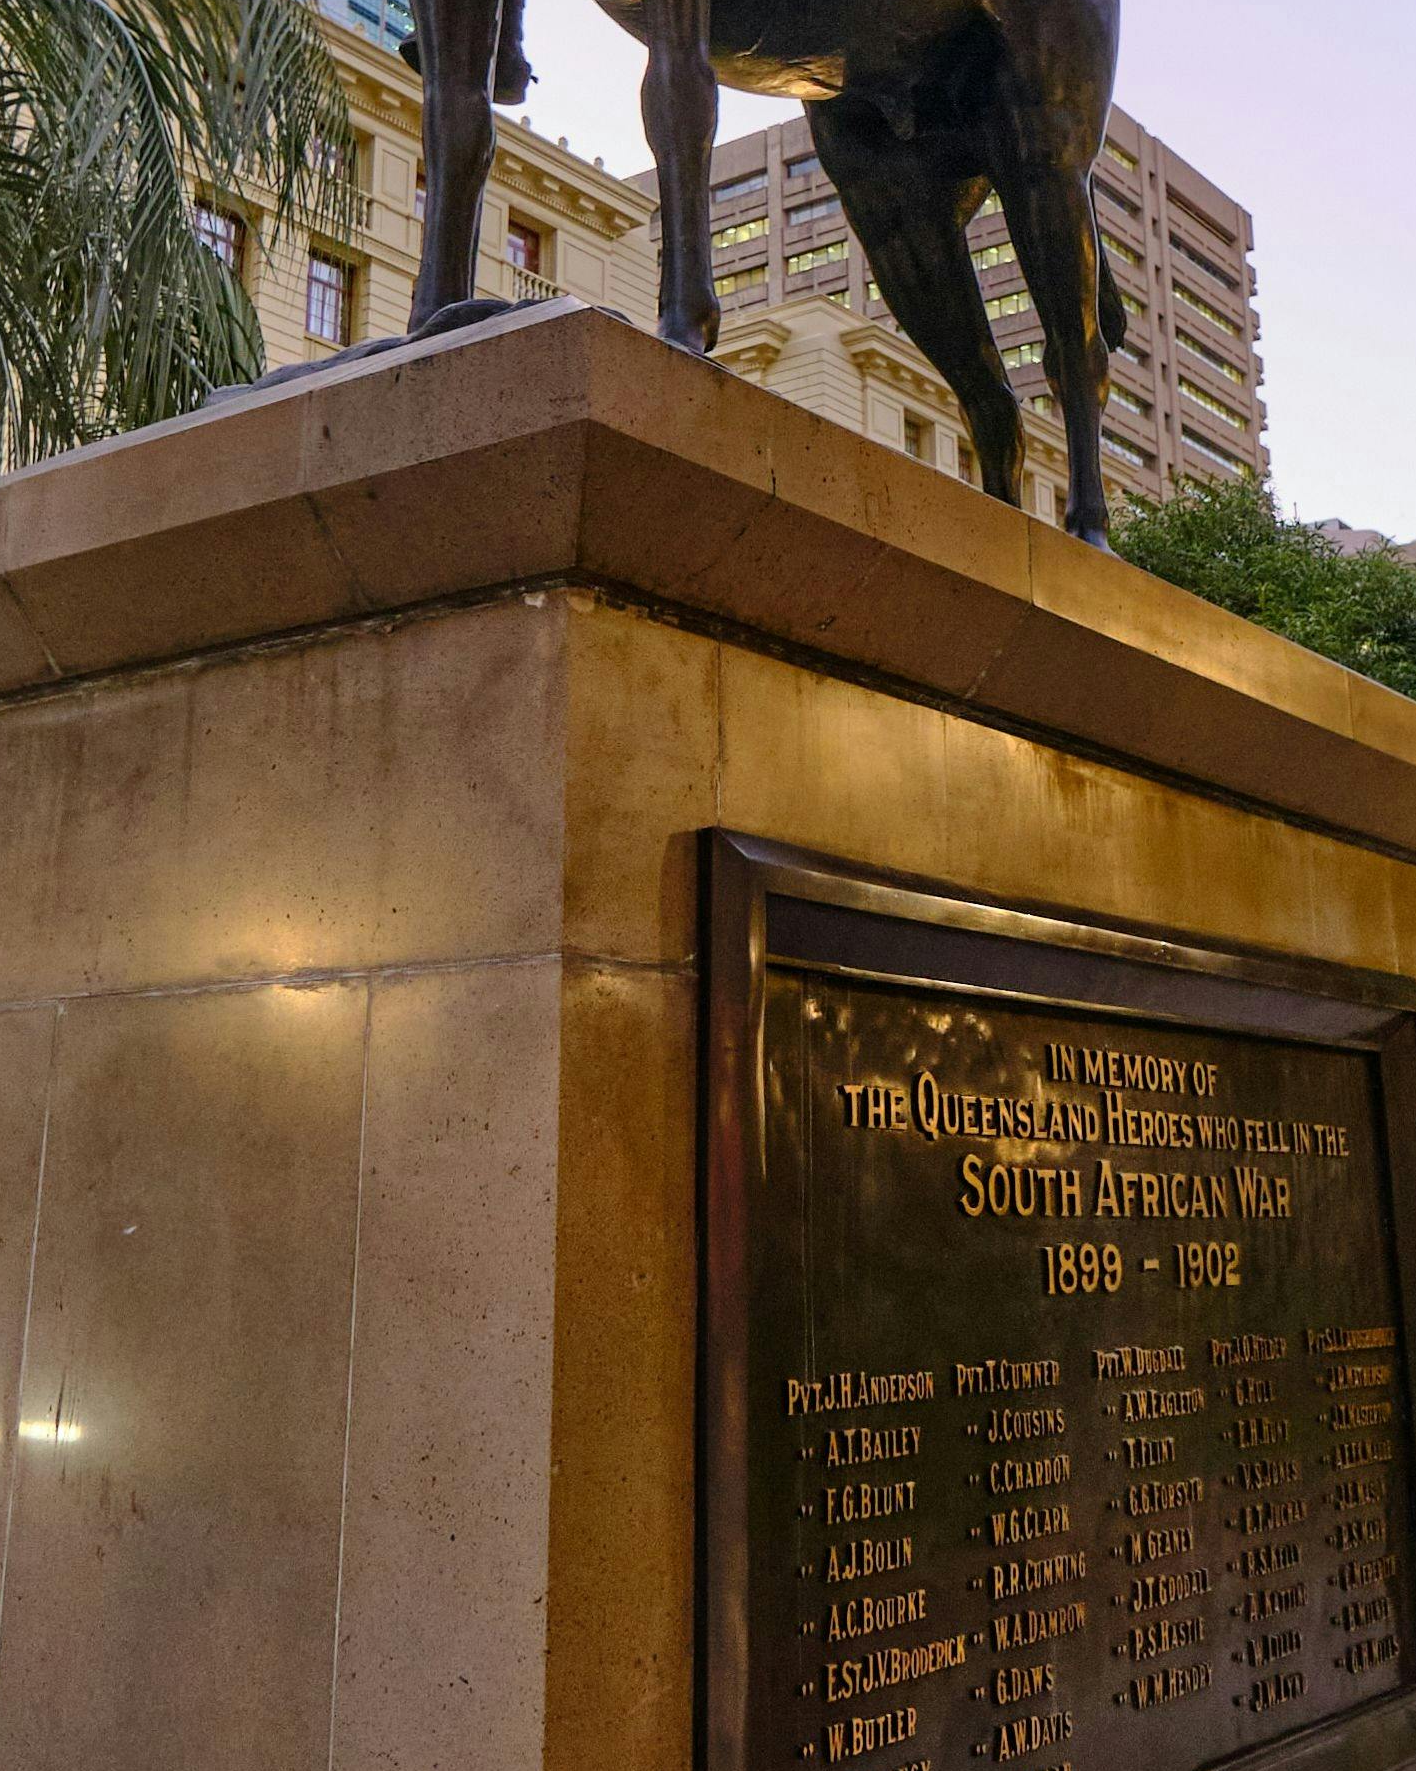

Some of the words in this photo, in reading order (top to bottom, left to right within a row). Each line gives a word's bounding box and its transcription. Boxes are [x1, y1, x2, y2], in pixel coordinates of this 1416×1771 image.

[1048, 1044, 1076, 1083] IN
[1081, 1048, 1187, 1093] MEMORY
[1192, 1061, 1218, 1097] OF
[839, 1084, 909, 1131] THE
[911, 1071, 1100, 1141] QUEENSLAND
[1105, 1091, 1194, 1149] HEROES
[1198, 1115, 1239, 1151] WHO
[1244, 1120, 1291, 1154] FELL
[1294, 1123, 1312, 1155] IN
[1313, 1124, 1350, 1157] THE
[959, 1155, 1083, 1217] SOUTH
[1094, 1159, 1230, 1218] AFRICAN
[1233, 1166, 1292, 1218] WAR
[1042, 1243, 1123, 1295] 1899
[1175, 1242, 1241, 1288] 1902
